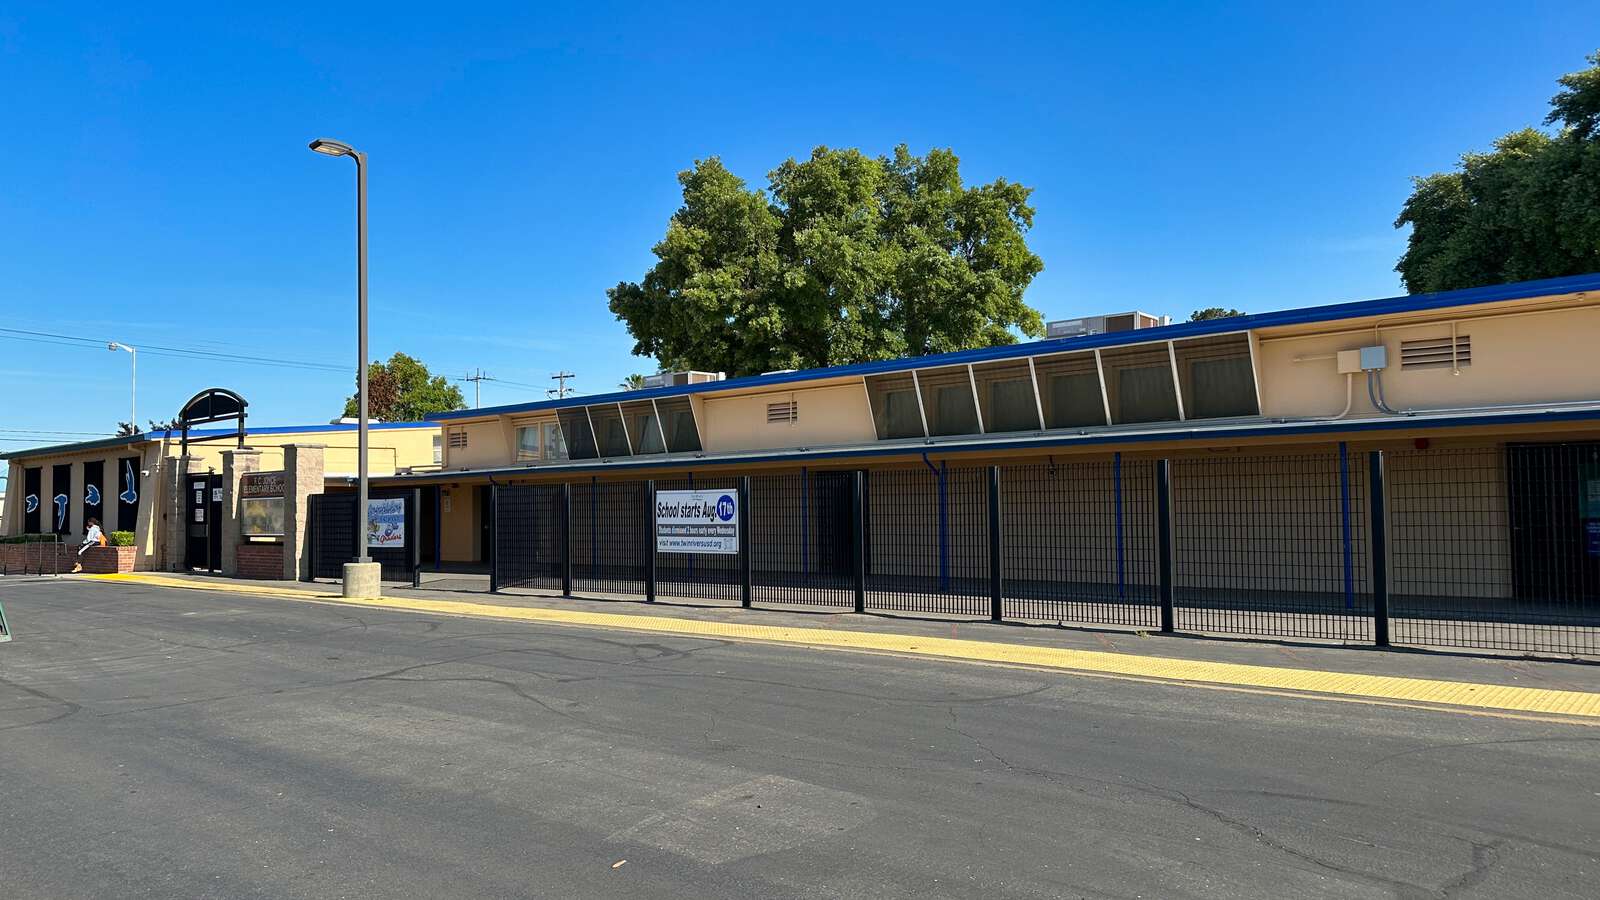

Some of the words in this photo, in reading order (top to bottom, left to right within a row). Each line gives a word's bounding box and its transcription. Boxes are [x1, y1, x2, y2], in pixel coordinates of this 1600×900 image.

[657, 501, 679, 518] School
[681, 502, 700, 518] starts
[702, 501, 717, 522] Aug.
[699, 526, 707, 536] early
[708, 526, 717, 536] every
[717, 525, 735, 536] Wednesday
